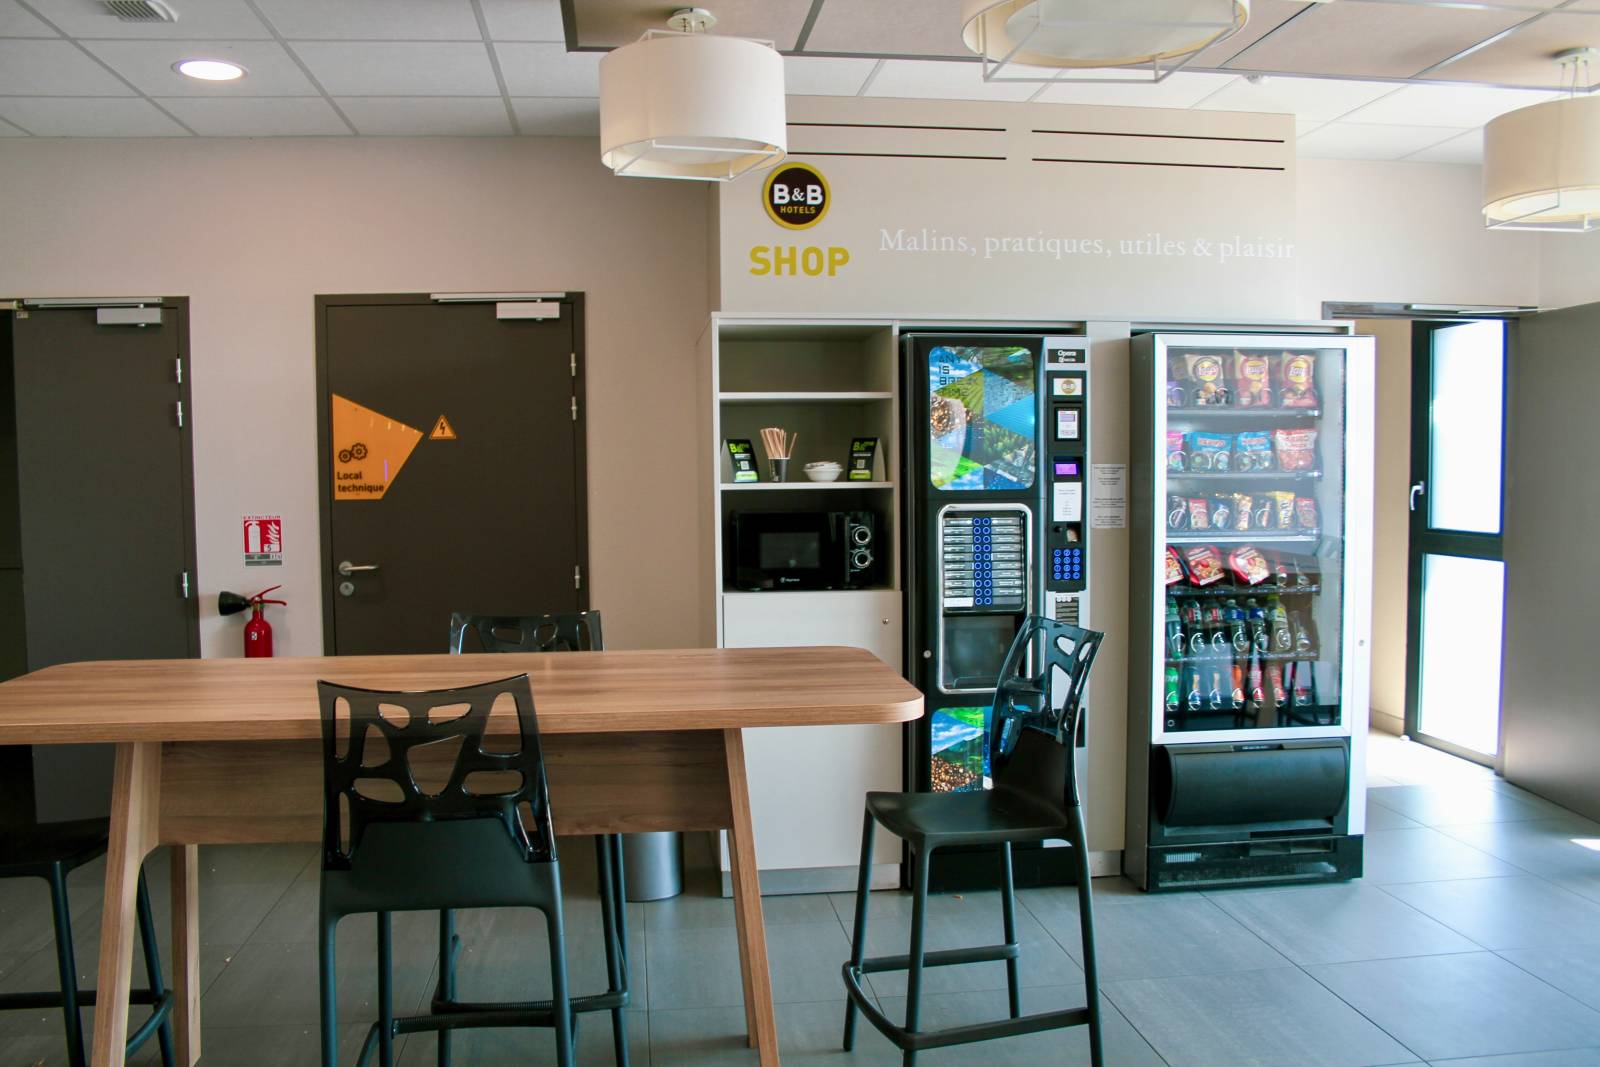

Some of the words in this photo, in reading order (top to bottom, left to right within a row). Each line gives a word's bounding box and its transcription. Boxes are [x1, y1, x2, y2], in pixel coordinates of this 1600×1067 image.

[773, 184, 823, 205] B&B
[780, 206, 816, 214] HOTELS
[879, 228, 977, 257] Malins,
[984, 230, 1112, 260] pratiques,
[1120, 233, 1185, 256] utiles
[1192, 238, 1212, 257] &
[1219, 235, 1296, 264] plaisir
[750, 246, 850, 277] SHOP
[336, 471, 363, 480] Local
[338, 483, 384, 493] technique
